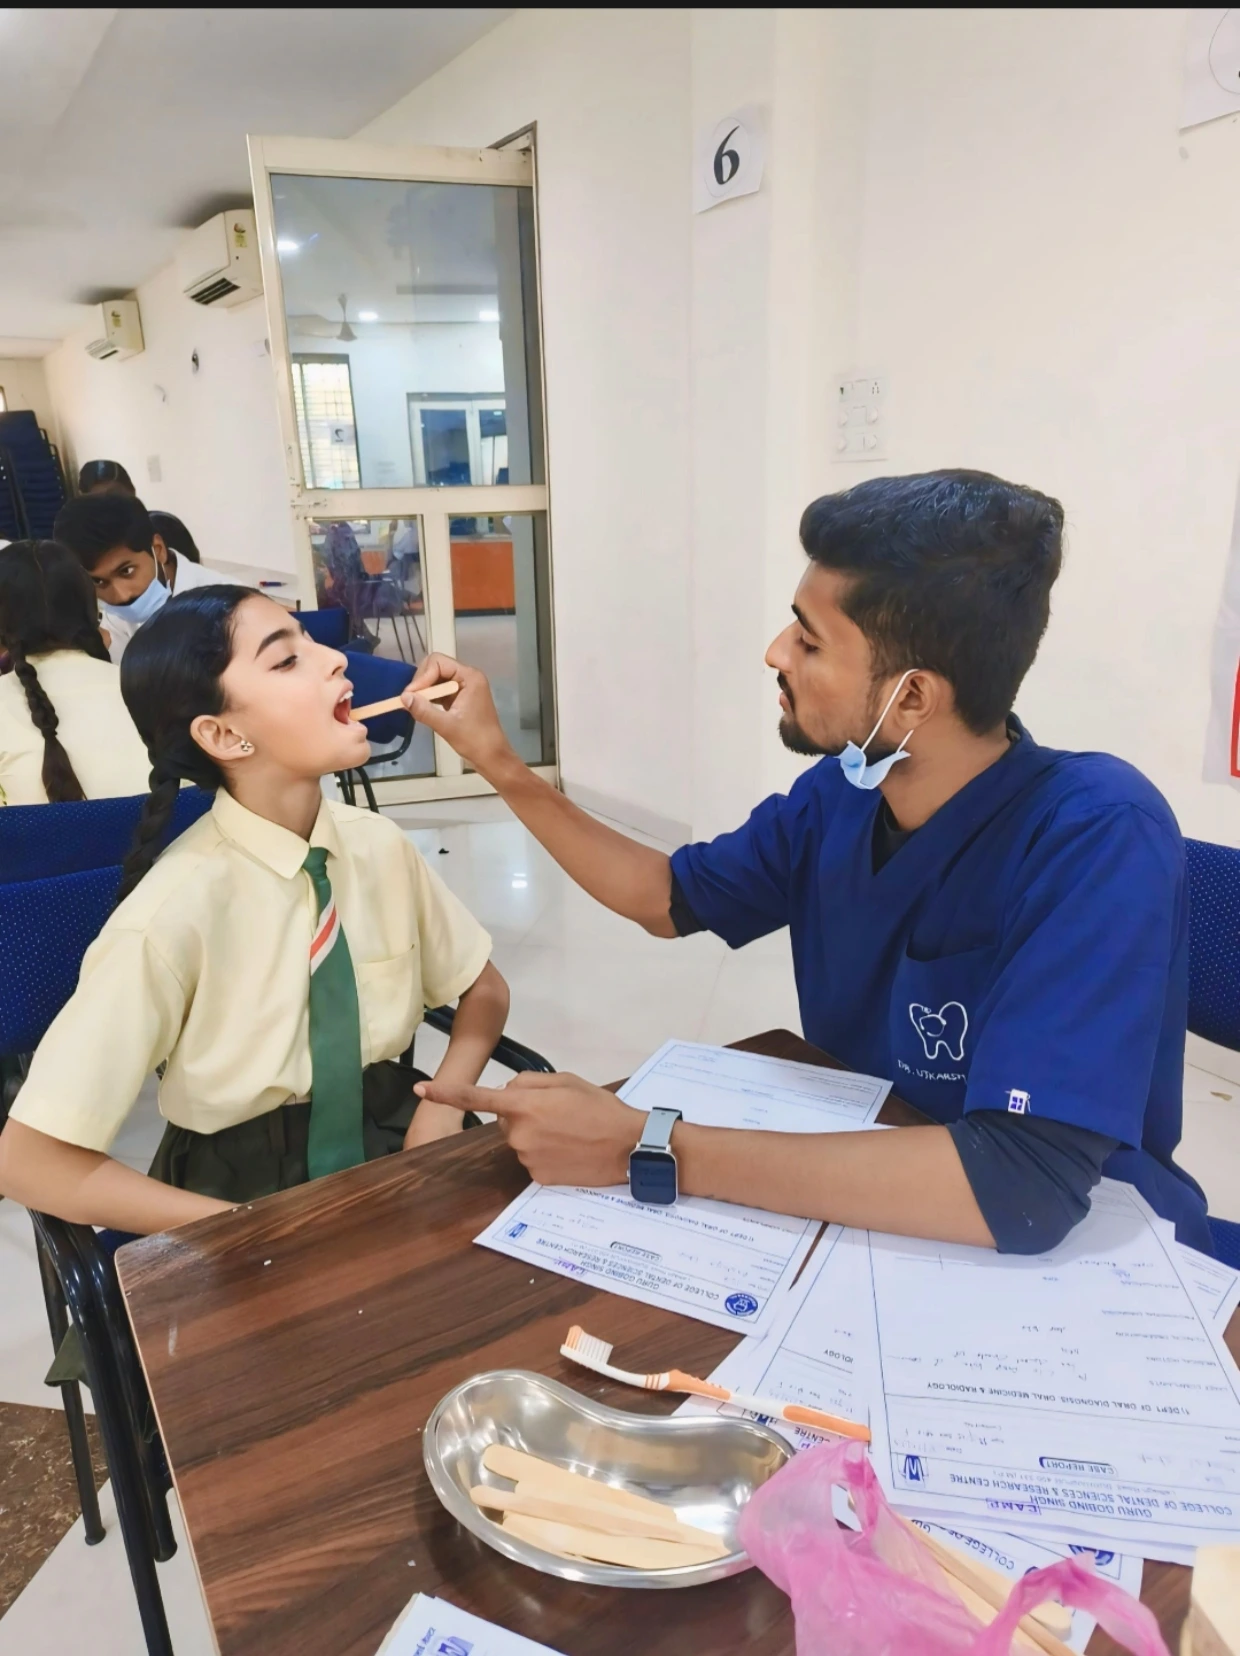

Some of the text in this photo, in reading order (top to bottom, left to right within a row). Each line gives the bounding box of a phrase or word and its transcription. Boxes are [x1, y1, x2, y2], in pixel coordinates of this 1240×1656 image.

[713, 125, 740, 185] 6
[536, 1238, 563, 1251] CENTRE
[564, 1244, 601, 1263] RESEARCH
[580, 1260, 659, 1290] GURU GOBIND SINGH
[608, 1260, 643, 1278] SCIENCES
[645, 1271, 672, 1285] DENTAL
[684, 1285, 720, 1301] COLLEGE
[823, 1349, 853, 1363] IOLOGY
[927, 1382, 977, 1393] RADIOLOGY
[989, 1387, 1029, 1399] MEDICINE
[1032, 1393, 1055, 1402] ORAL
[1111, 1401, 1137, 1410] ORAL
[1046, 1461, 1114, 1474] CASE REPORT
[949, 1474, 1233, 1516] COLLEGE OF DENTAL SCIENCES & RESEARCH CENTRE
[1029, 1495, 1152, 1518] GURU GOBIND SINGH
[965, 1537, 1015, 1570] COLLEGE
